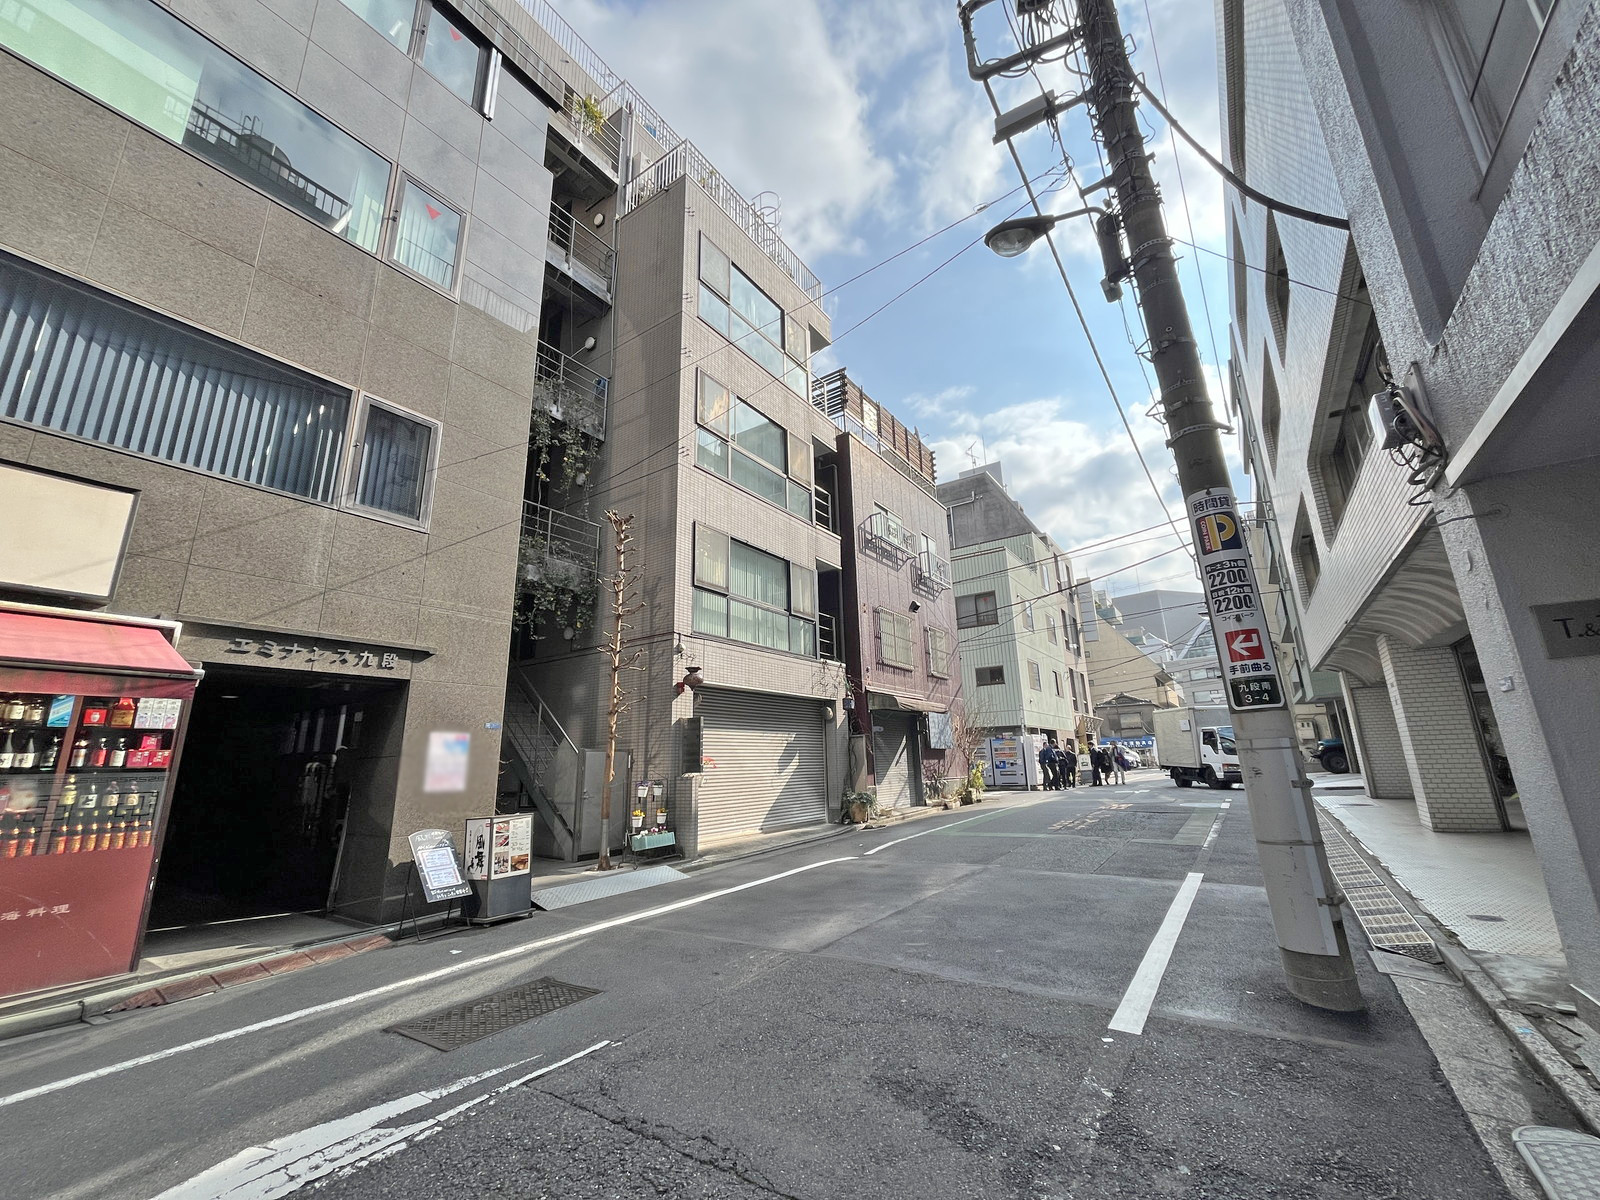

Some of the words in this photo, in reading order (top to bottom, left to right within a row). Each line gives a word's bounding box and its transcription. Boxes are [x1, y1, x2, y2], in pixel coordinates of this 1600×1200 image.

[1193, 496, 1230, 513] 時間貸
[231, 638, 399, 668] エミナンス九段
[1229, 662, 1271, 675] 手前曲る
[1239, 682, 1271, 692] 九段南
[1245, 693, 1269, 703] 3-4
